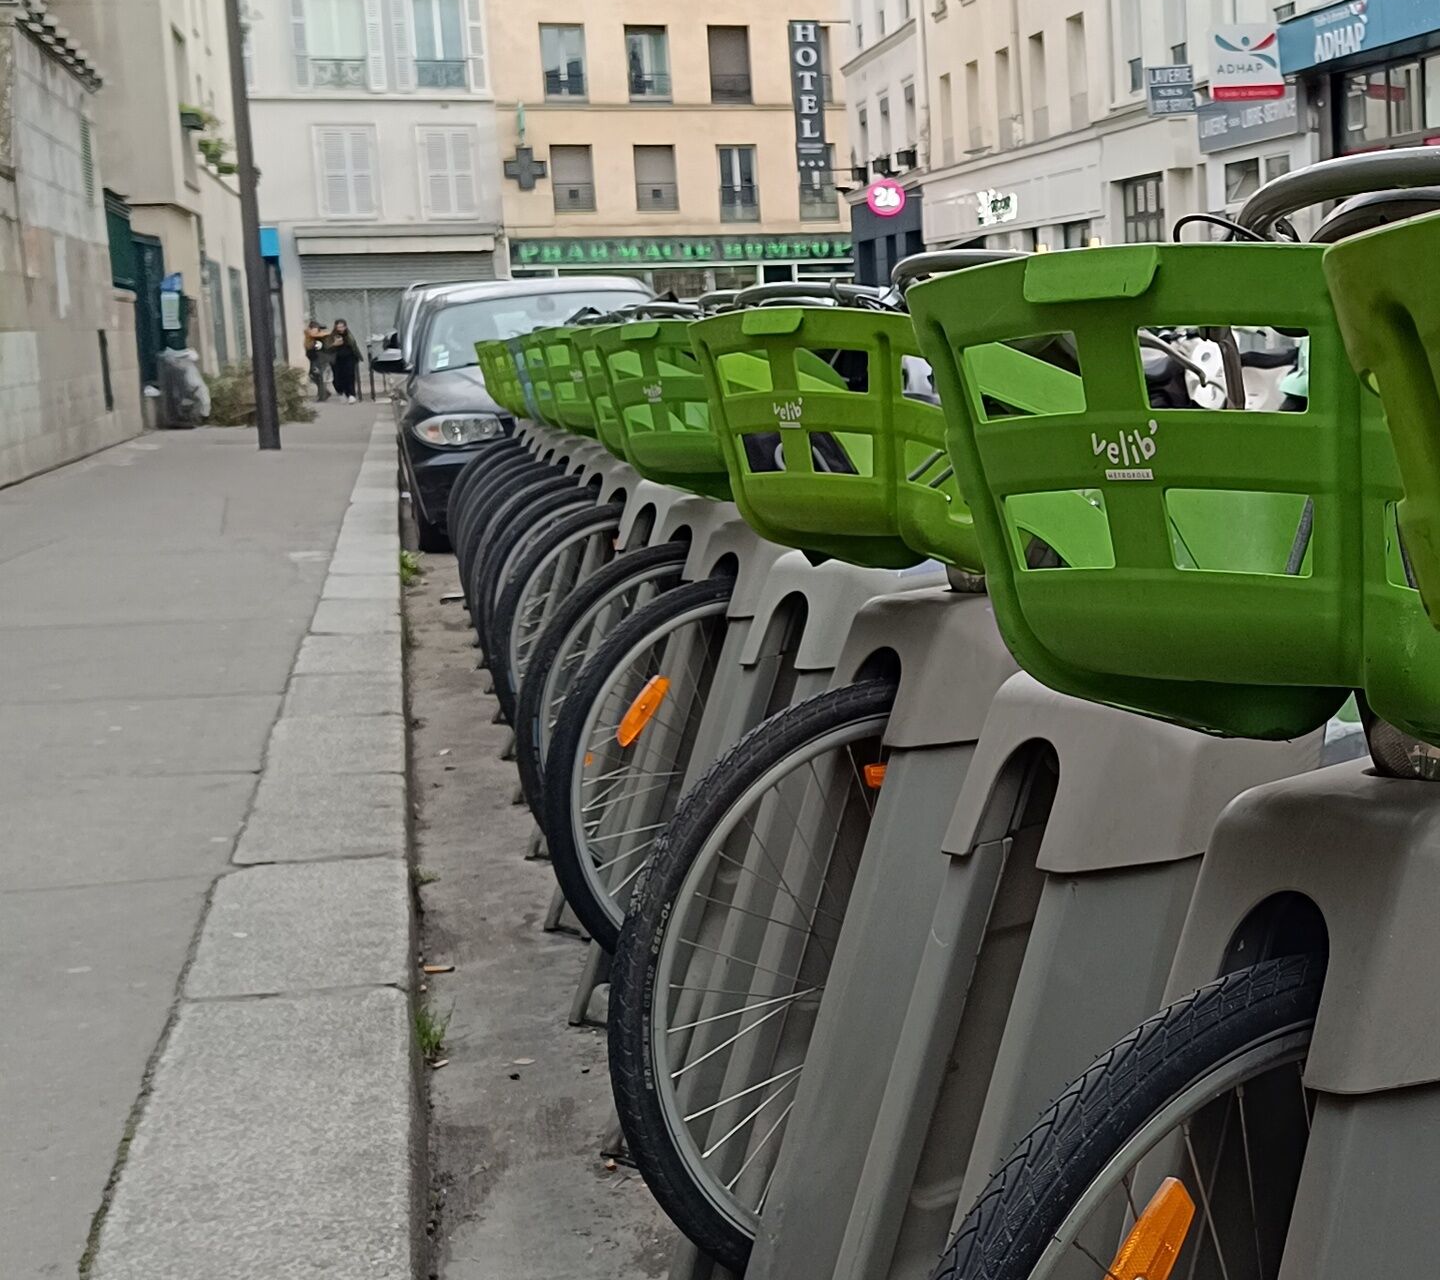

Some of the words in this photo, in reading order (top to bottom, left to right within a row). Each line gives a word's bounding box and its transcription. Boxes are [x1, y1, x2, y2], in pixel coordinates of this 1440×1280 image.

[1314, 23, 1365, 63] ADHAP
[794, 24, 820, 138] HOTEL
[1217, 62, 1264, 75] ADHAP
[520, 242, 712, 261] PHARMACIE
